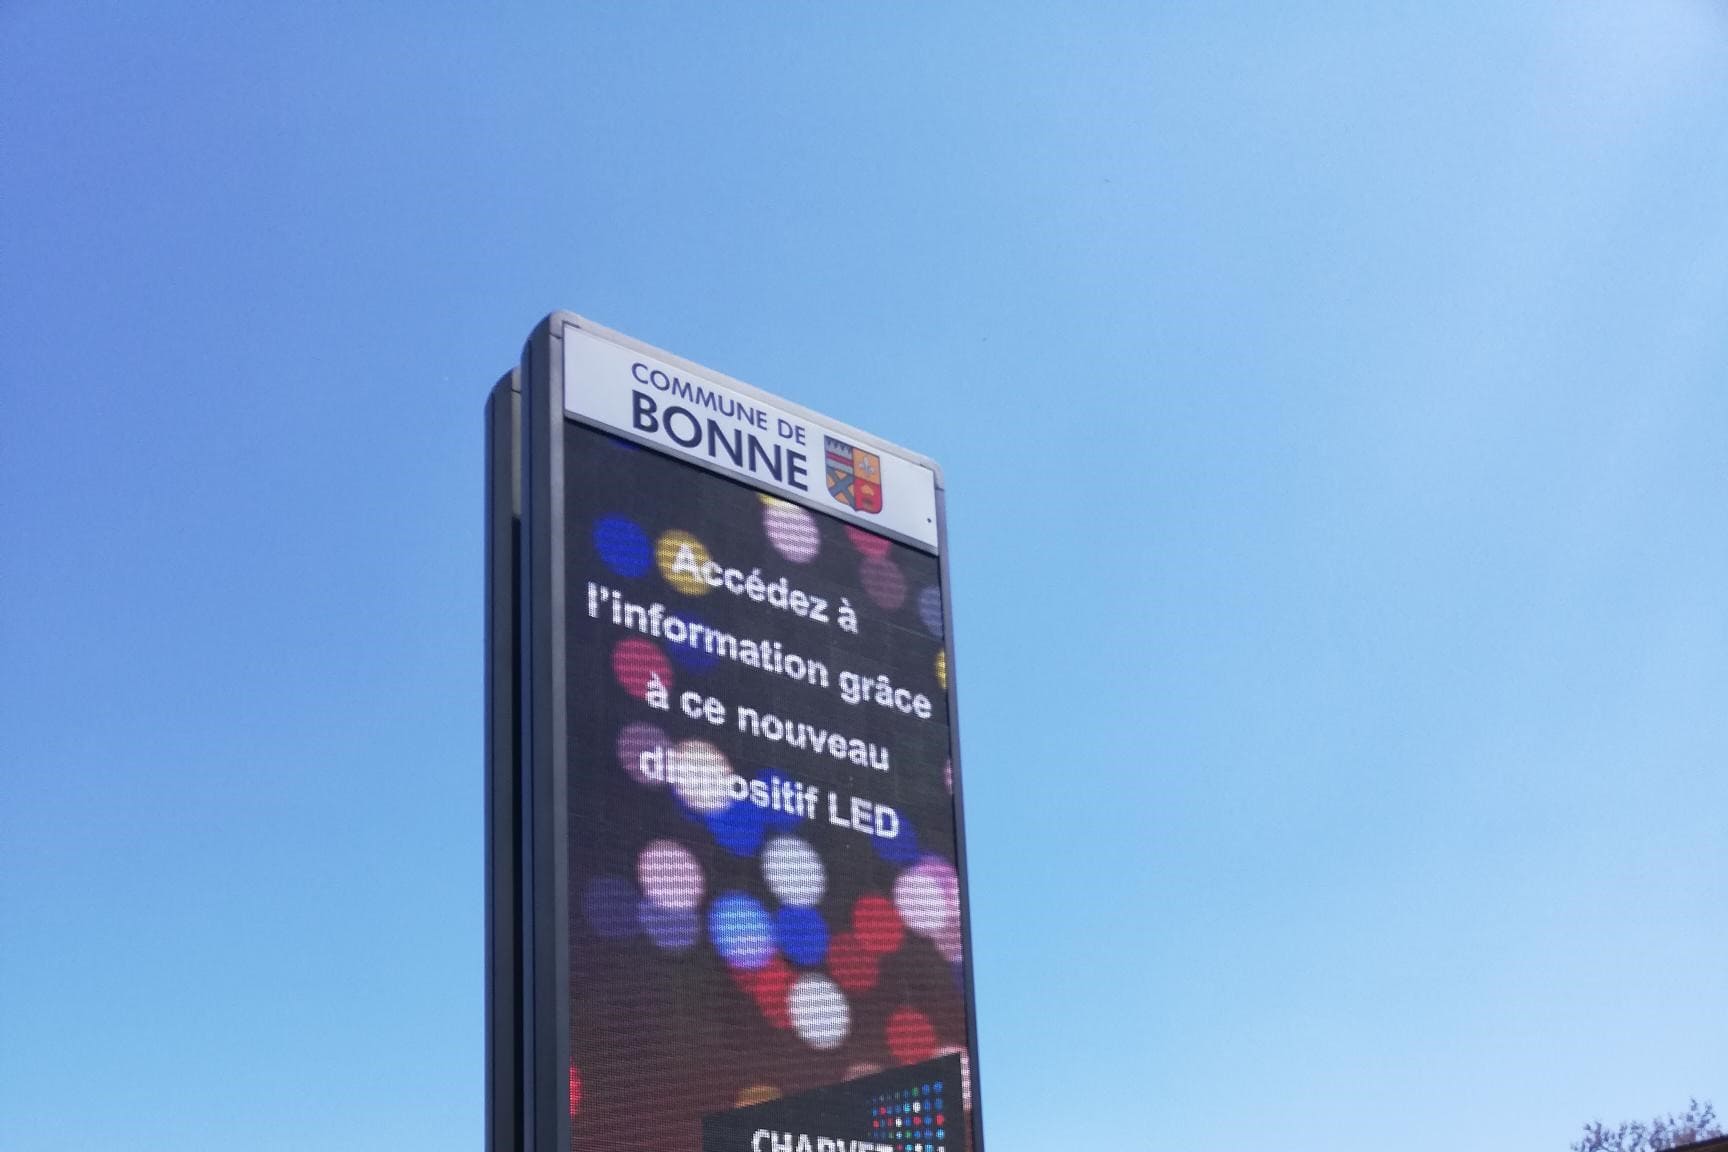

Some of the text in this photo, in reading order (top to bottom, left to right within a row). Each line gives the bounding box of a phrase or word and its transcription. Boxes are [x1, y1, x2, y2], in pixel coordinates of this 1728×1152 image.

[632, 362, 805, 446] COMMUNE DE
[632, 389, 808, 492] BONNE
[672, 543, 858, 634] Accédez à
[587, 581, 932, 719] l'information grâce
[646, 670, 889, 771] à ce nouveau
[639, 745, 899, 839] diositif LED
